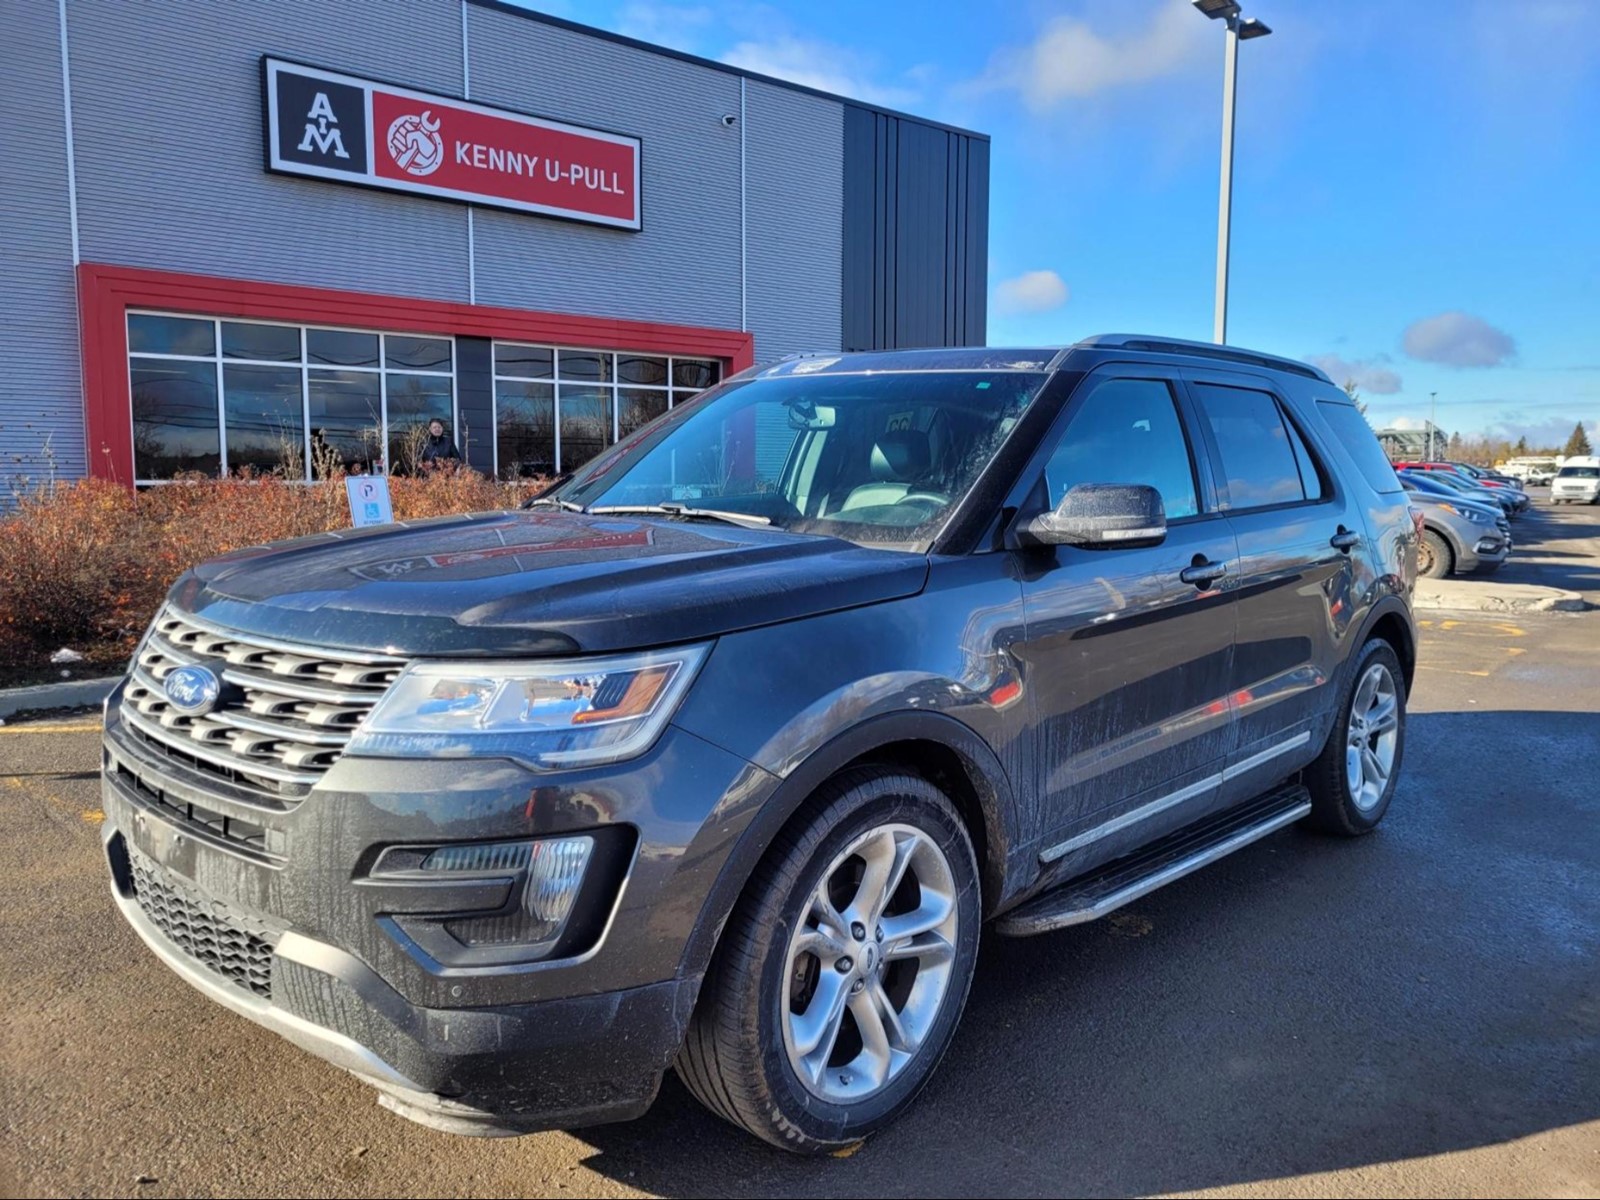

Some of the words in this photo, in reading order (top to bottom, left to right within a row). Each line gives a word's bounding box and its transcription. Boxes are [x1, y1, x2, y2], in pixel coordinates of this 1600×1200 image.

[455, 141, 538, 177] KENNY
[545, 159, 625, 194] U-PULL
[168, 671, 199, 702] Ford
